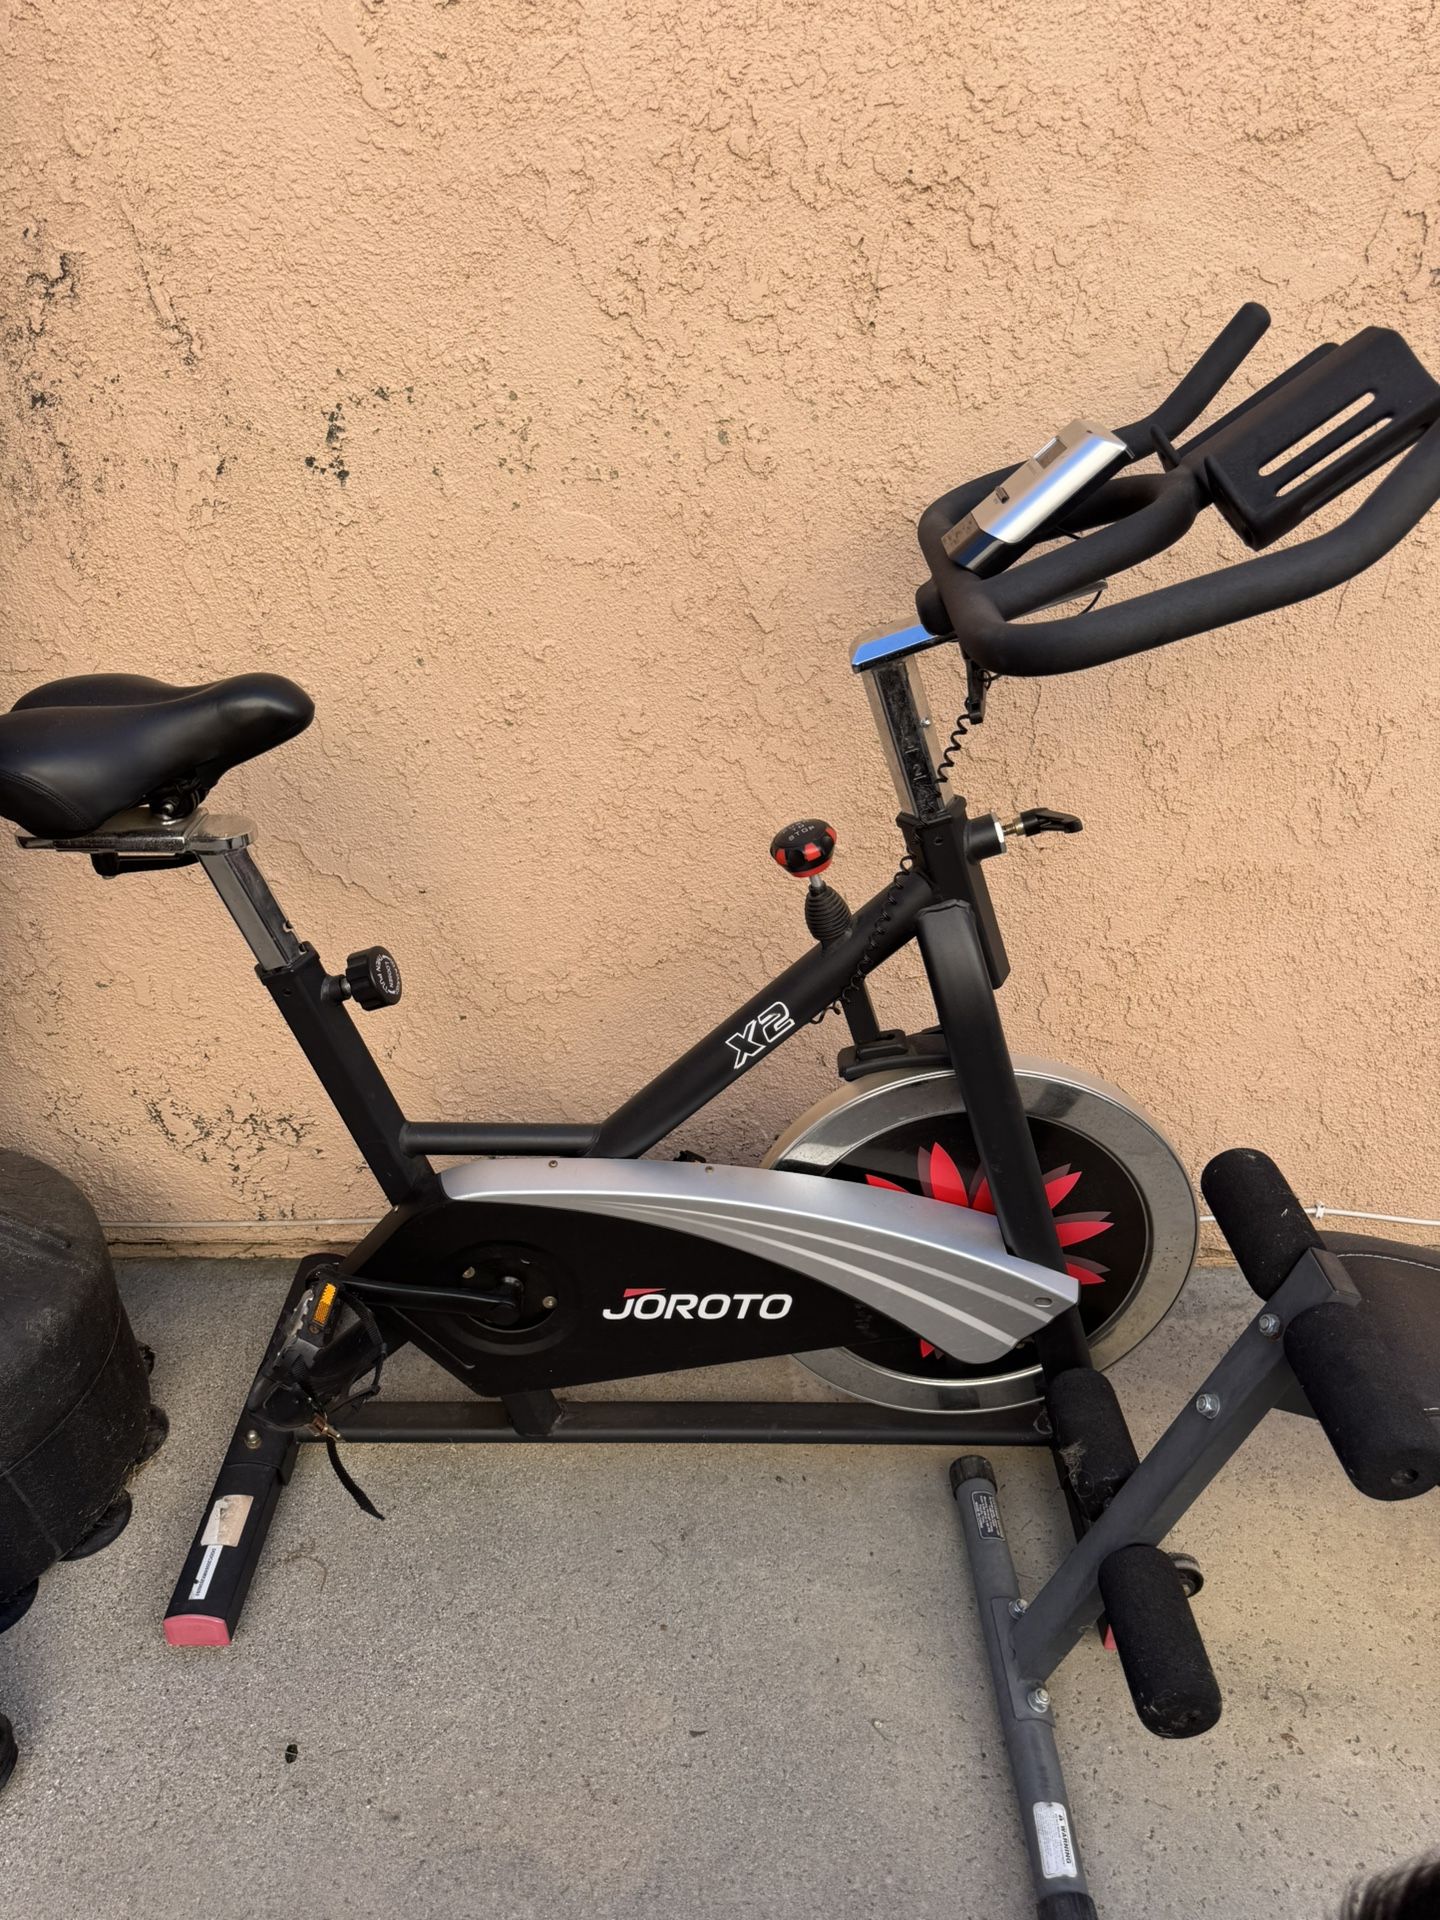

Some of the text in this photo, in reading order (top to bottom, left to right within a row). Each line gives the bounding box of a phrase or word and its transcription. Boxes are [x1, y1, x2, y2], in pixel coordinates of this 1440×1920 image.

[788, 825, 815, 841] STOP
[384, 961, 394, 988] LOOSEN
[725, 1001, 796, 1070] X2
[602, 1288, 793, 1320] JOROTO
[1060, 1825, 1072, 1864] WARNING
